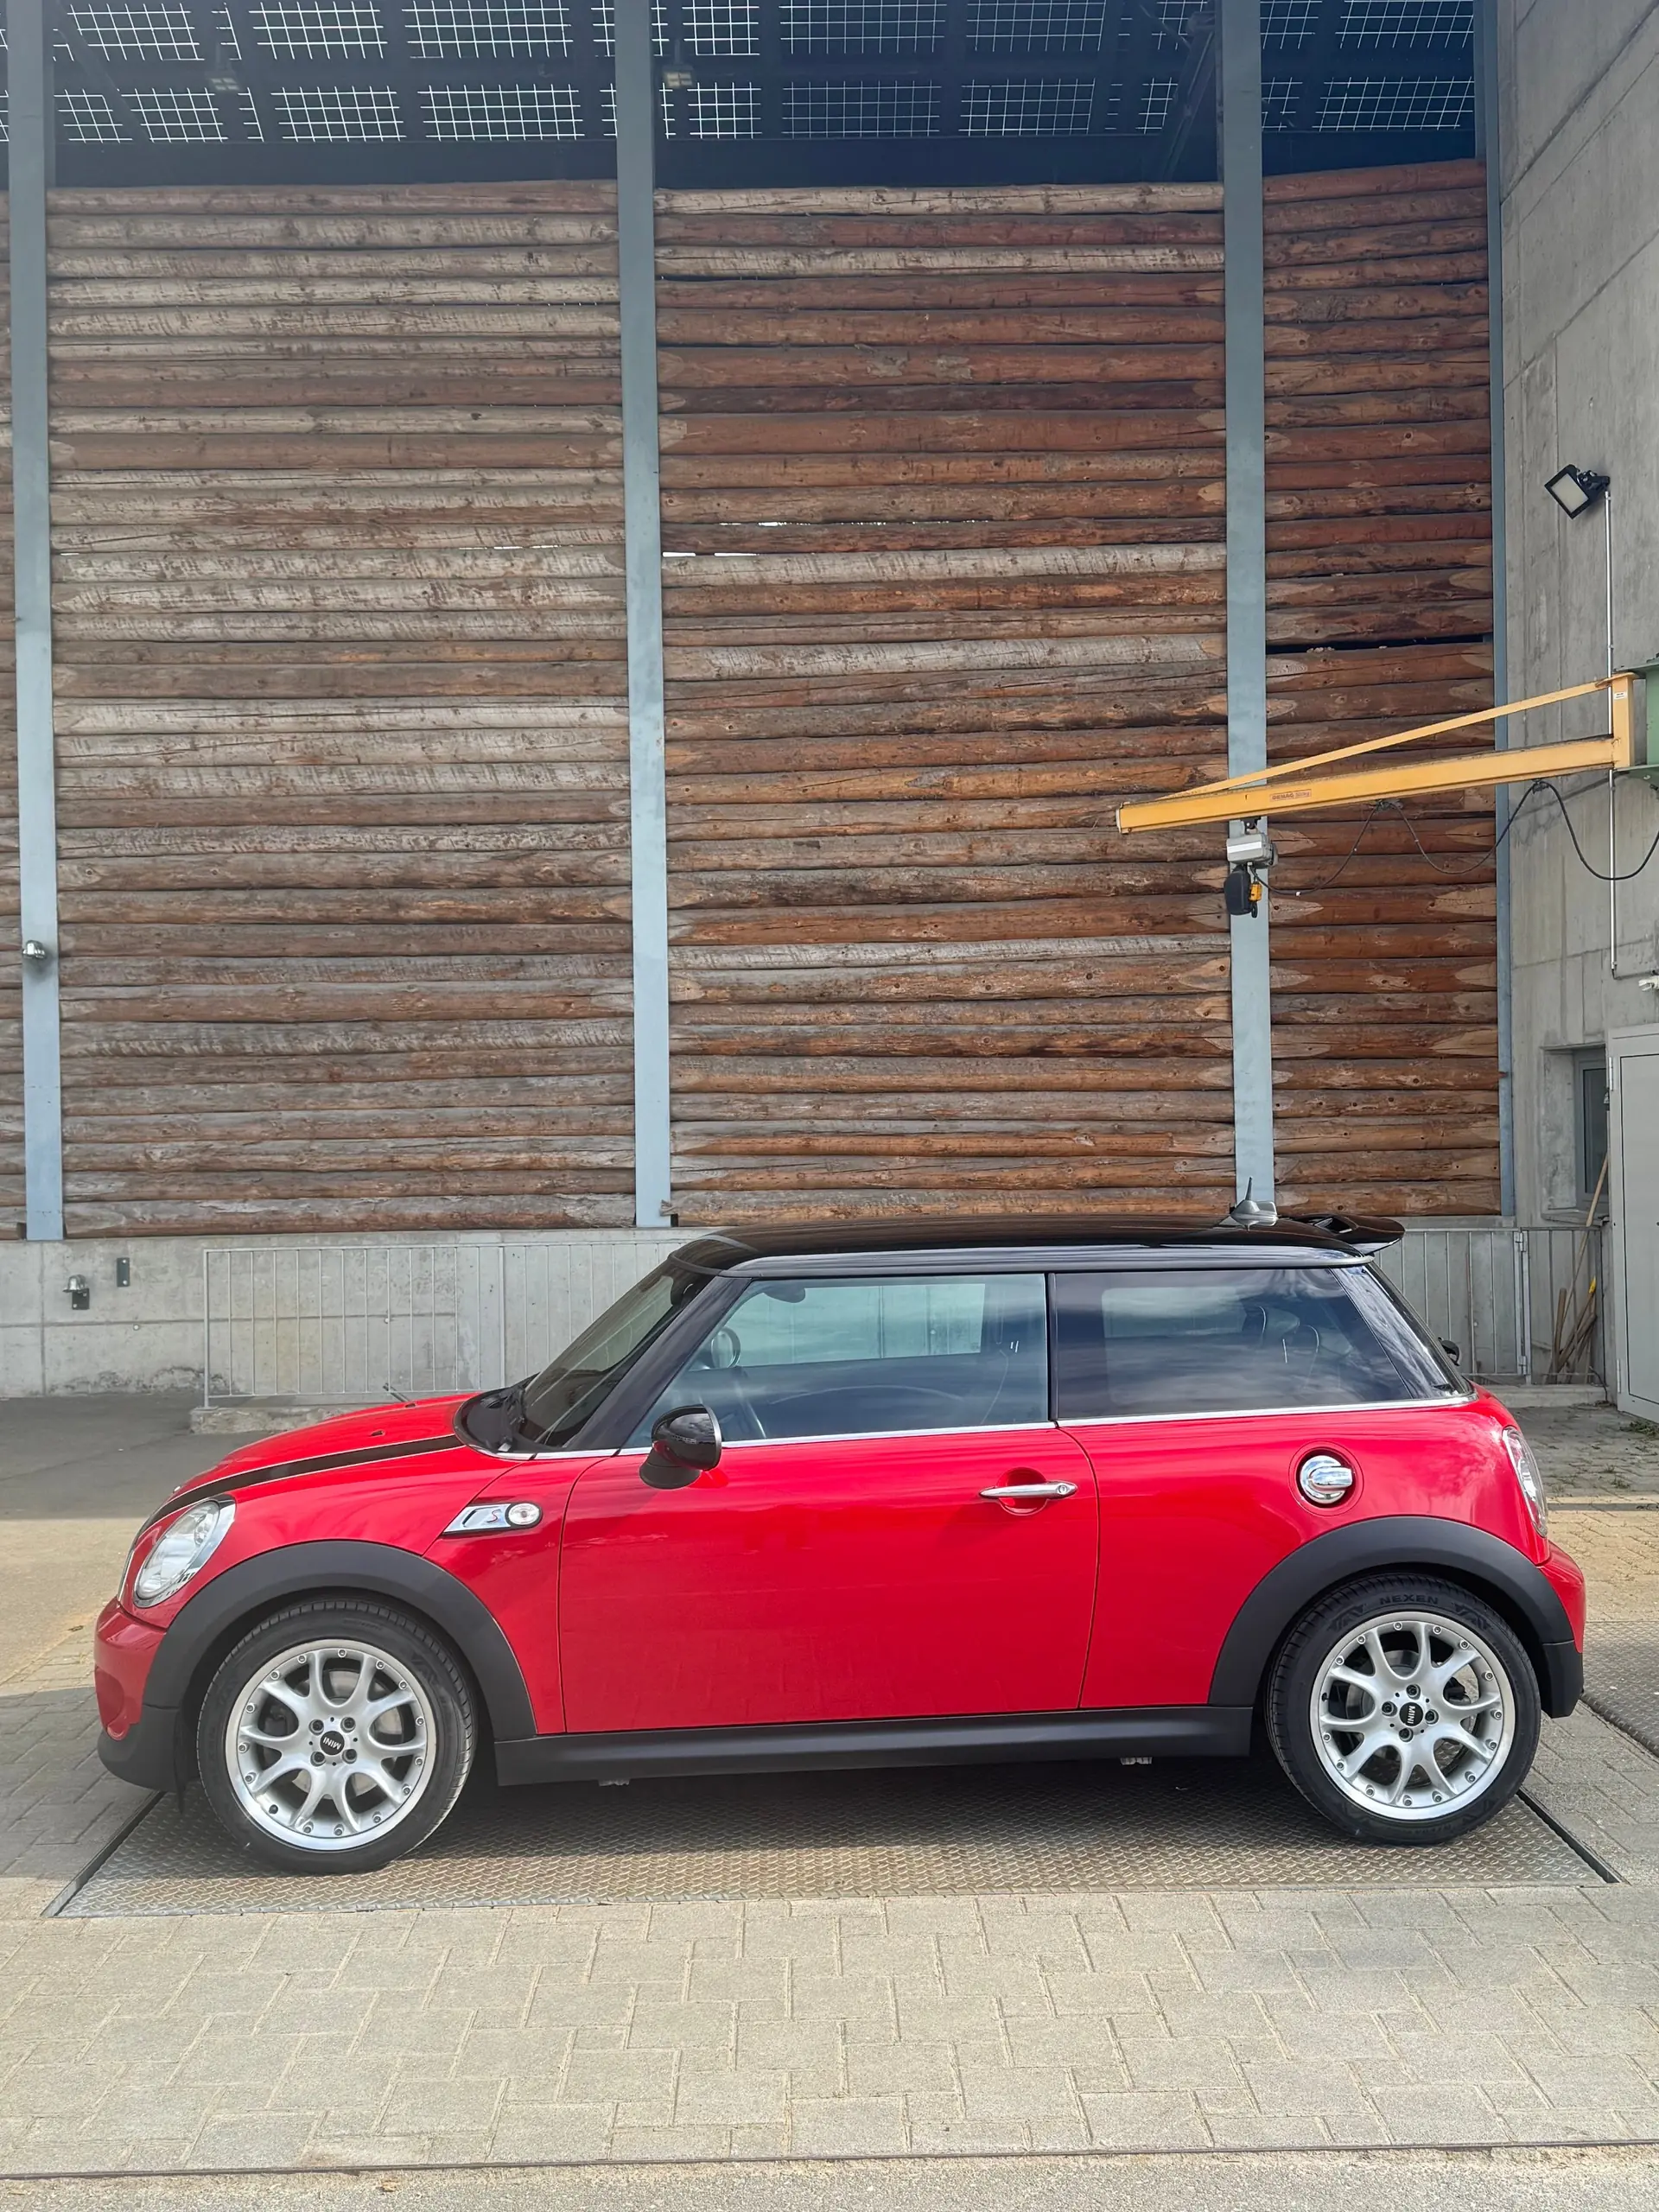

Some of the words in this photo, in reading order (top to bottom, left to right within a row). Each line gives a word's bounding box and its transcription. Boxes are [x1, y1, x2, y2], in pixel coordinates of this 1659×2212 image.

[1379, 1593, 1439, 1605] NEXEN
[1407, 1705, 1416, 1724] MINI
[322, 1737, 342, 1750] MINI
